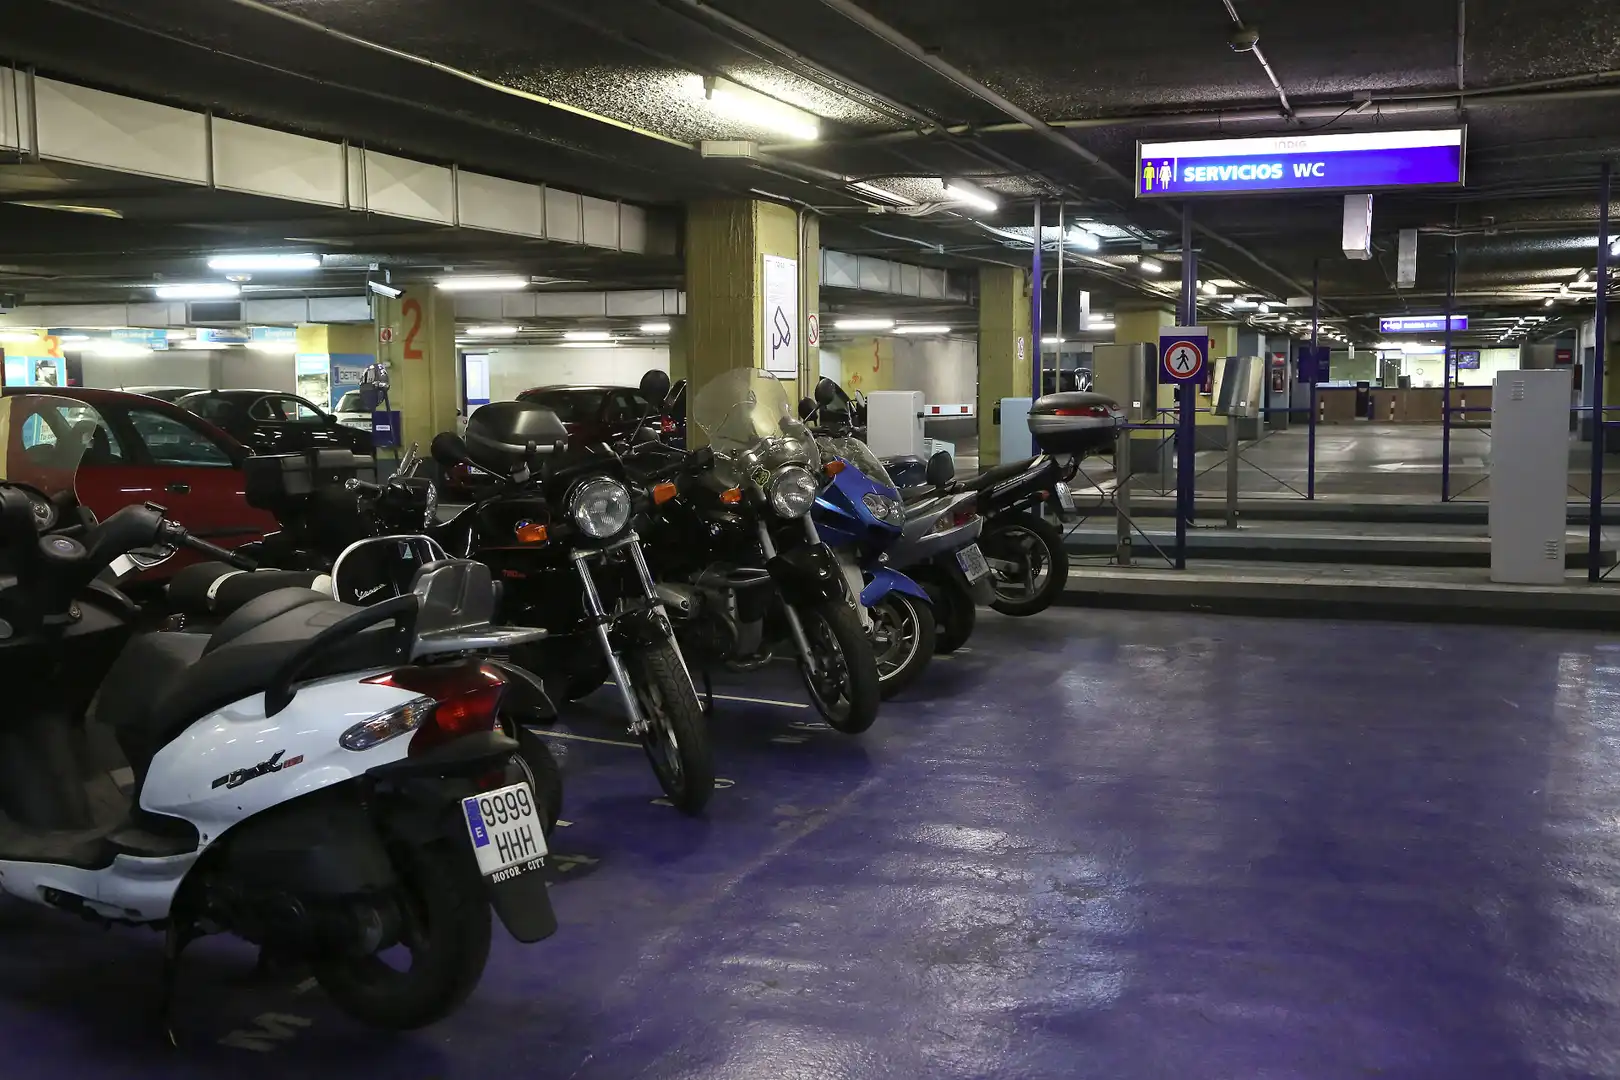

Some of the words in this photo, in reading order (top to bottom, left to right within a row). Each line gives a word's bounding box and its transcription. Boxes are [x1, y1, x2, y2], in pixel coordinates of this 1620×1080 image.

[1183, 162, 1283, 183] SERVICIOS
[1292, 162, 1325, 178] WC
[402, 298, 423, 360] 2
[480, 788, 532, 827] 9999
[475, 827, 484, 838] E
[495, 824, 538, 864] HHH
[492, 866, 522, 884] MOTOR
[527, 857, 546, 871] CITY
